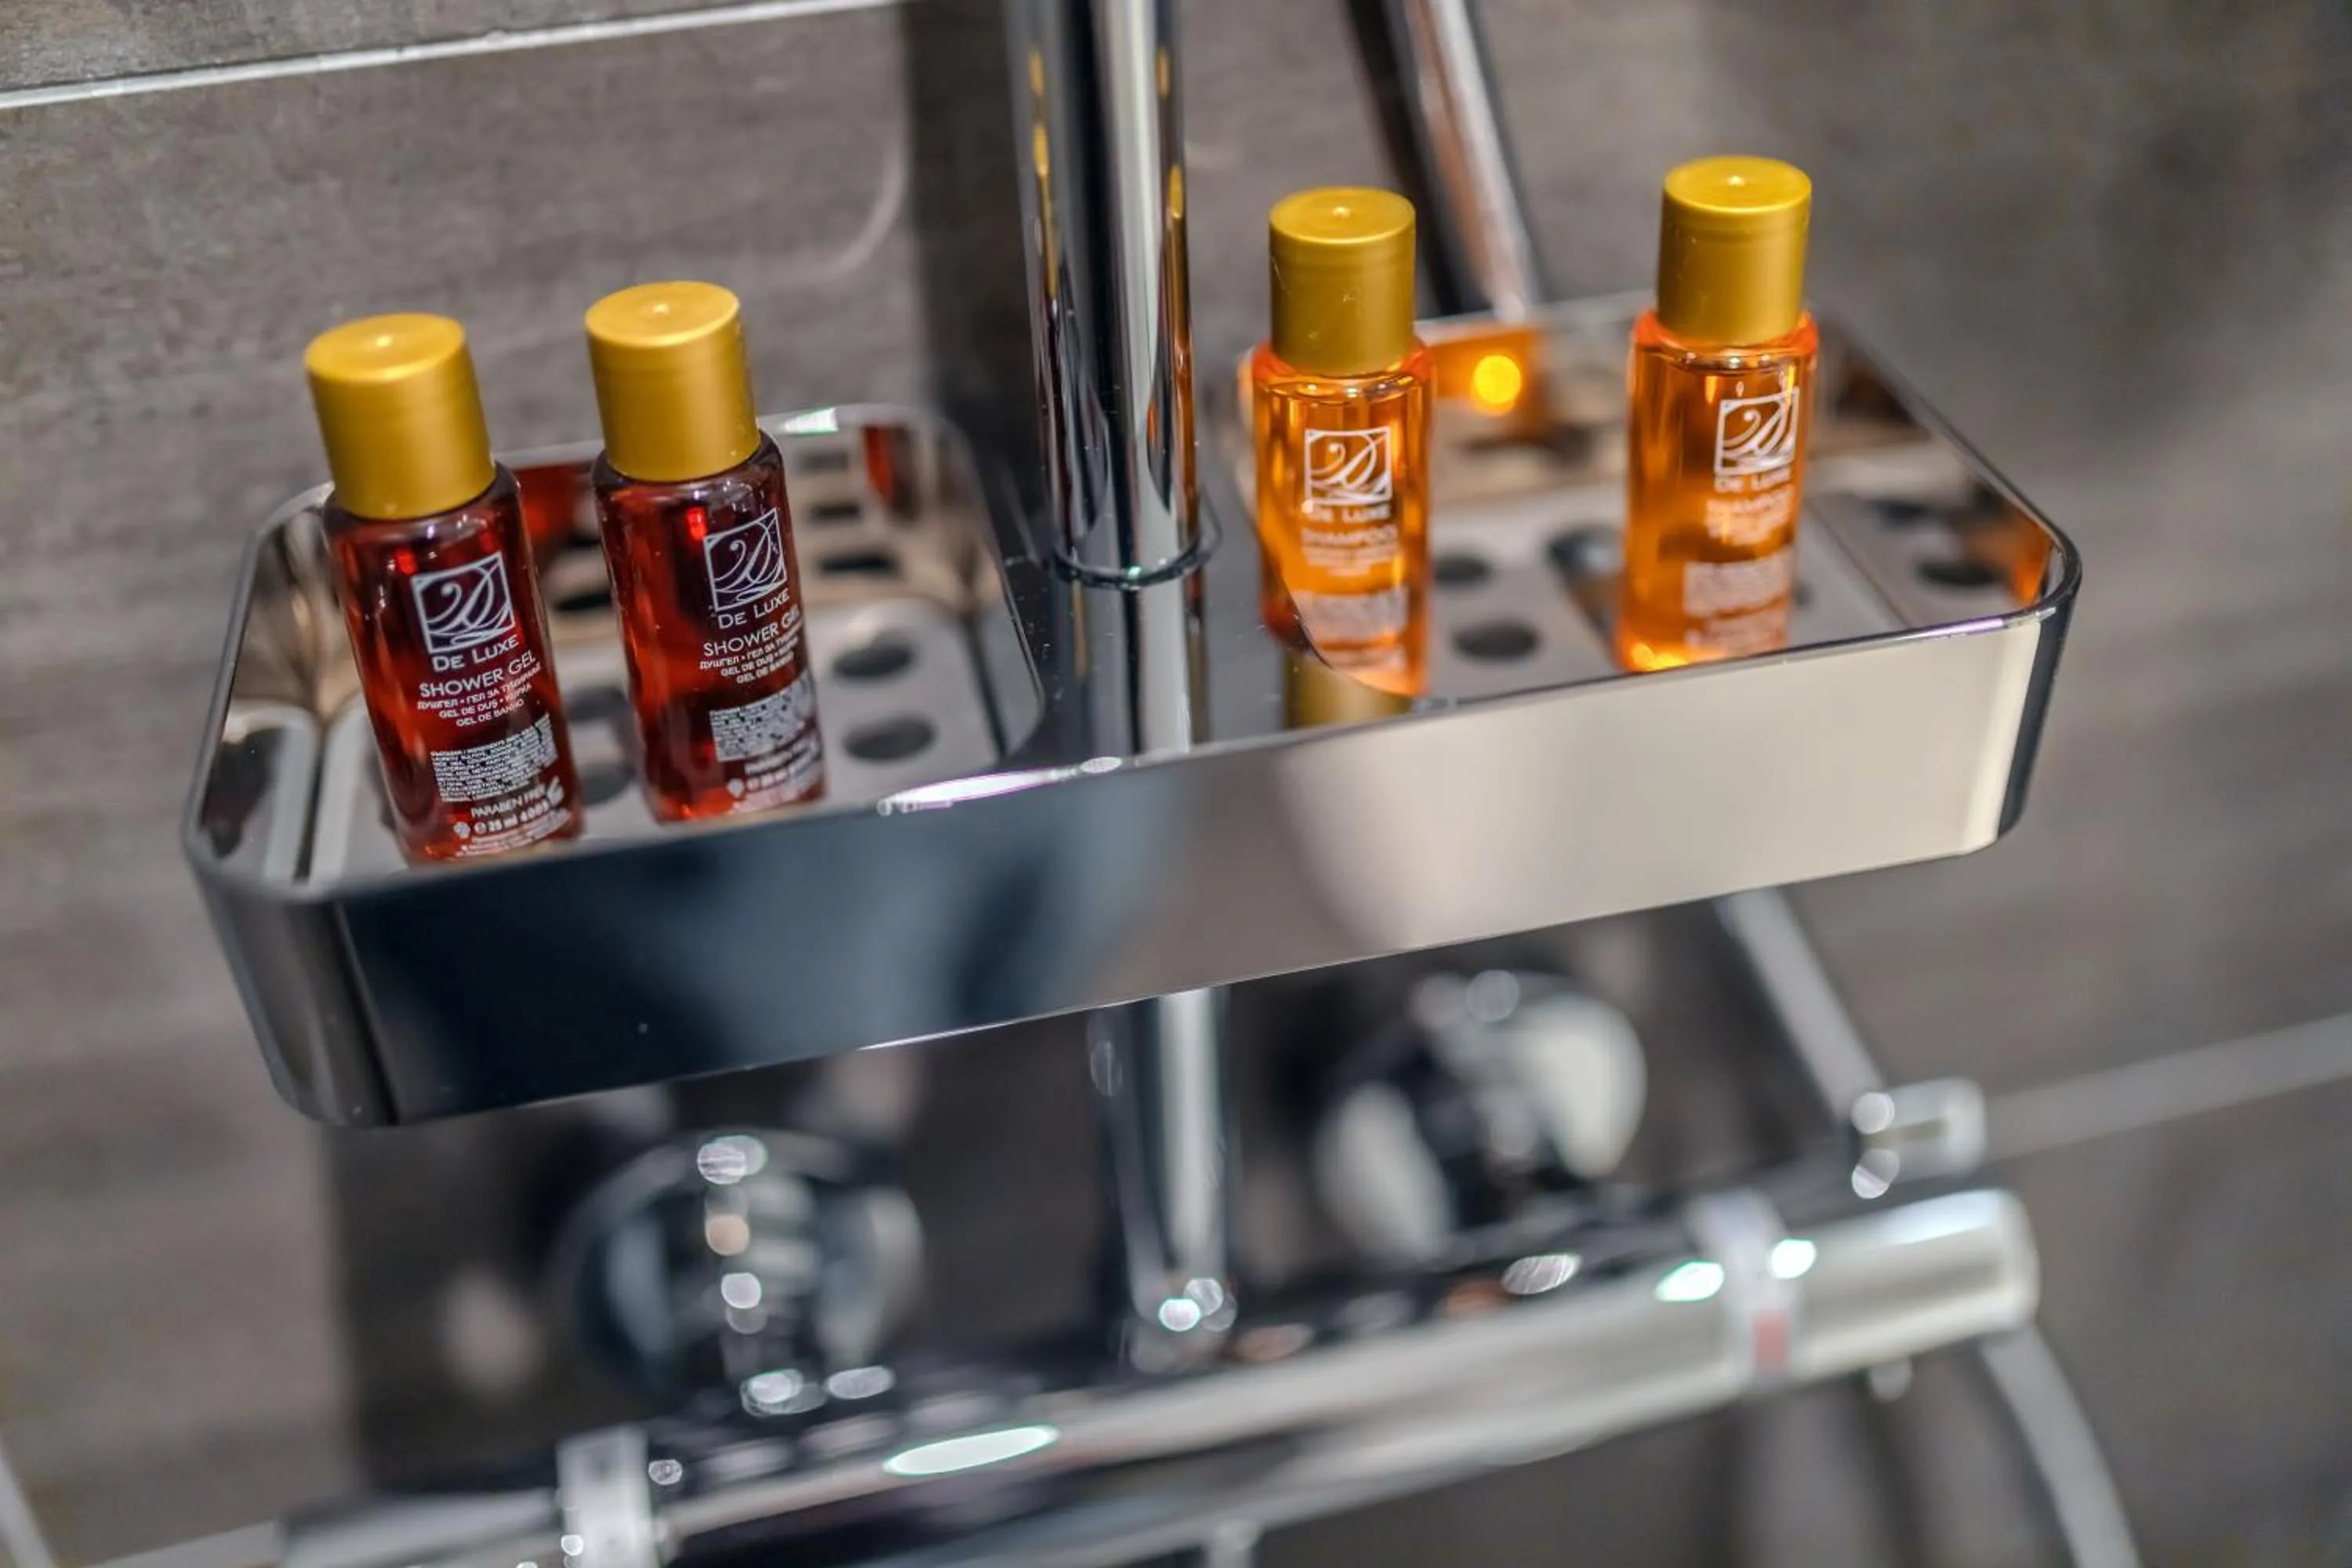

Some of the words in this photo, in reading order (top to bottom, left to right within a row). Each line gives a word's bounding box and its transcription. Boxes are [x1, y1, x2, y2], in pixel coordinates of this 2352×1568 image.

[718, 612, 747, 629] DE
[753, 588, 790, 618] LUXE
[432, 655, 464, 672] DE
[471, 634, 520, 663] LUXE
[703, 622, 779, 656] SHOWER
[419, 668, 505, 698] SHOWER
[507, 649, 536, 675] GEL
[720, 666, 741, 677] GEL
[439, 709, 460, 719] GEL
[456, 717, 477, 728] GEL
